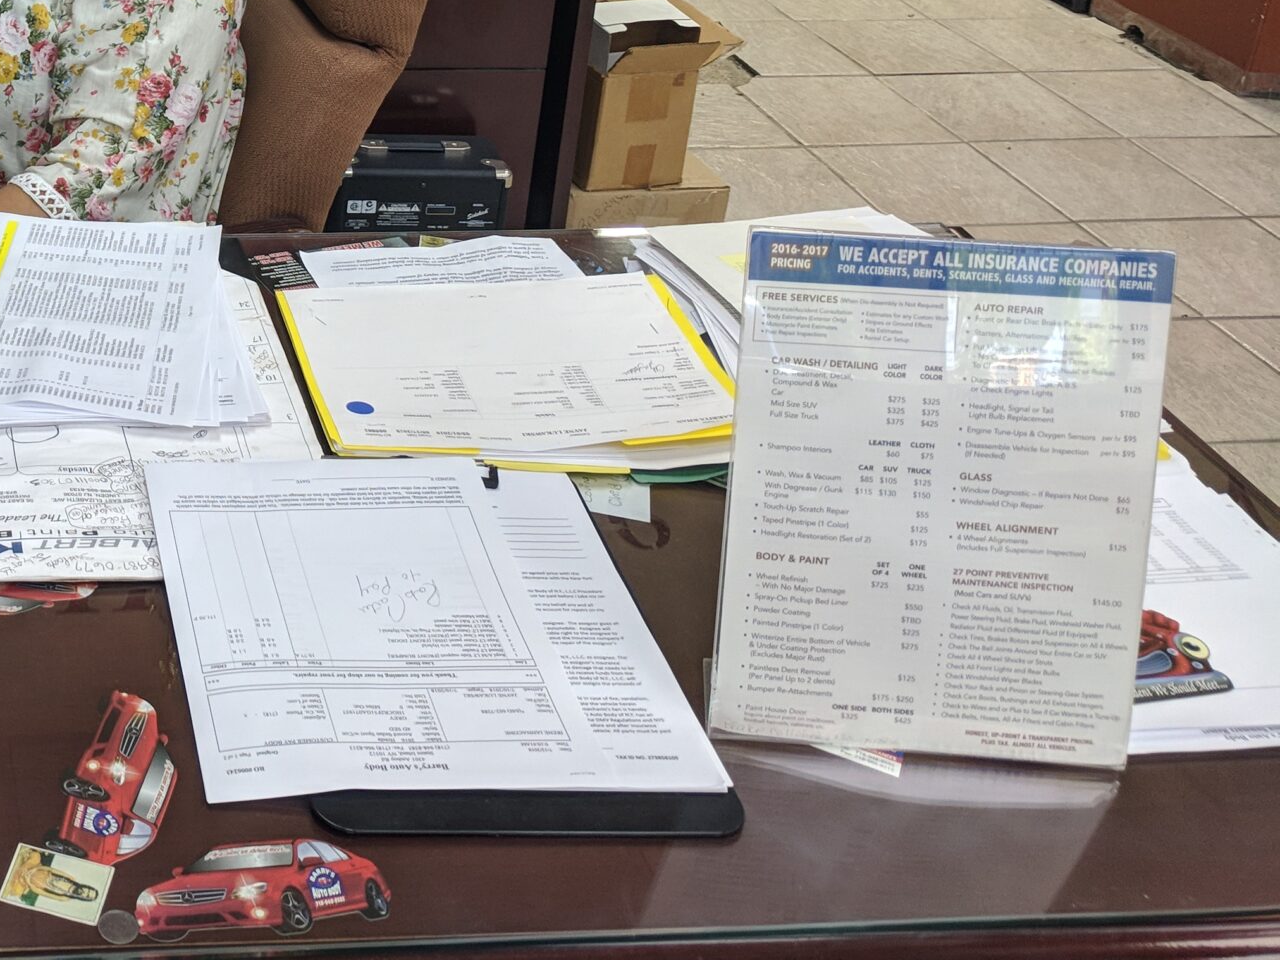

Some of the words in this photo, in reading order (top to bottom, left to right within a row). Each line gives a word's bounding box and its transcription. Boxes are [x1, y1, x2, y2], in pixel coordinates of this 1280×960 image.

[770, 257, 812, 270] PRICING
[839, 246, 863, 262] WE
[868, 247, 928, 266] ACCEPT
[934, 251, 963, 268] ALL
[968, 253, 1058, 273] INSURANCE
[1065, 258, 1158, 279] COMPANIES
[838, 264, 856, 274] FOR
[858, 265, 911, 280] ACCIDENTS,
[913, 268, 947, 281] DENTS,
[949, 270, 1002, 285] SCRATCHES,
[1005, 274, 1034, 285] GLASS
[1036, 276, 1056, 286] AND
[1059, 276, 1117, 290] MECHANICAL
[1119, 280, 1156, 292] REPAIR.
[762, 291, 788, 302] FREE
[791, 293, 839, 305] SERVICES
[974, 303, 1005, 315] AUTO
[1006, 304, 1044, 316] REPAIR
[772, 357, 791, 366] CAR
[793, 358, 822, 368] WASH
[830, 360, 879, 372] DETAILING
[888, 363, 908, 372] LIGHT
[924, 365, 944, 373] DARK
[883, 371, 907, 380] COLOR
[920, 373, 944, 382] COLOR
[887, 396, 906, 405] $275
[922, 398, 941, 407] $325
[922, 409, 940, 418] $375
[920, 420, 939, 429] $425
[868, 440, 901, 448] LEATHER
[909, 441, 935, 450] CLOTH
[920, 452, 934, 460] $75
[56, 465, 95, 474] Tuesday
[858, 464, 874, 472] CAR
[882, 465, 898, 473] SUV
[907, 467, 932, 475] TRUCK
[959, 471, 993, 482] GLASS
[913, 478, 932, 487] $125
[26, 528, 99, 537] Paint
[955, 521, 992, 532] WHEEL
[995, 523, 1059, 536] ALIGNMENT
[755, 551, 785, 562] BODY
[798, 555, 831, 566] PAINT
[876, 561, 890, 569] SET
[908, 563, 925, 571] ONE
[901, 571, 927, 580] WHEEL
[952, 568, 964, 576] 27
[965, 568, 994, 578] POINT
[995, 570, 1049, 581] PREVENTIVE
[952, 578, 1019, 590] MAINTENANCE
[1021, 582, 1075, 593] INSPECTION
[1170, 682, 1199, 696] Should
[363, 762, 388, 772] Body
[390, 762, 412, 771] Auto
[413, 763, 450, 772] Barry's
[311, 886, 329, 900] AUTO
[327, 880, 342, 897] BODY
